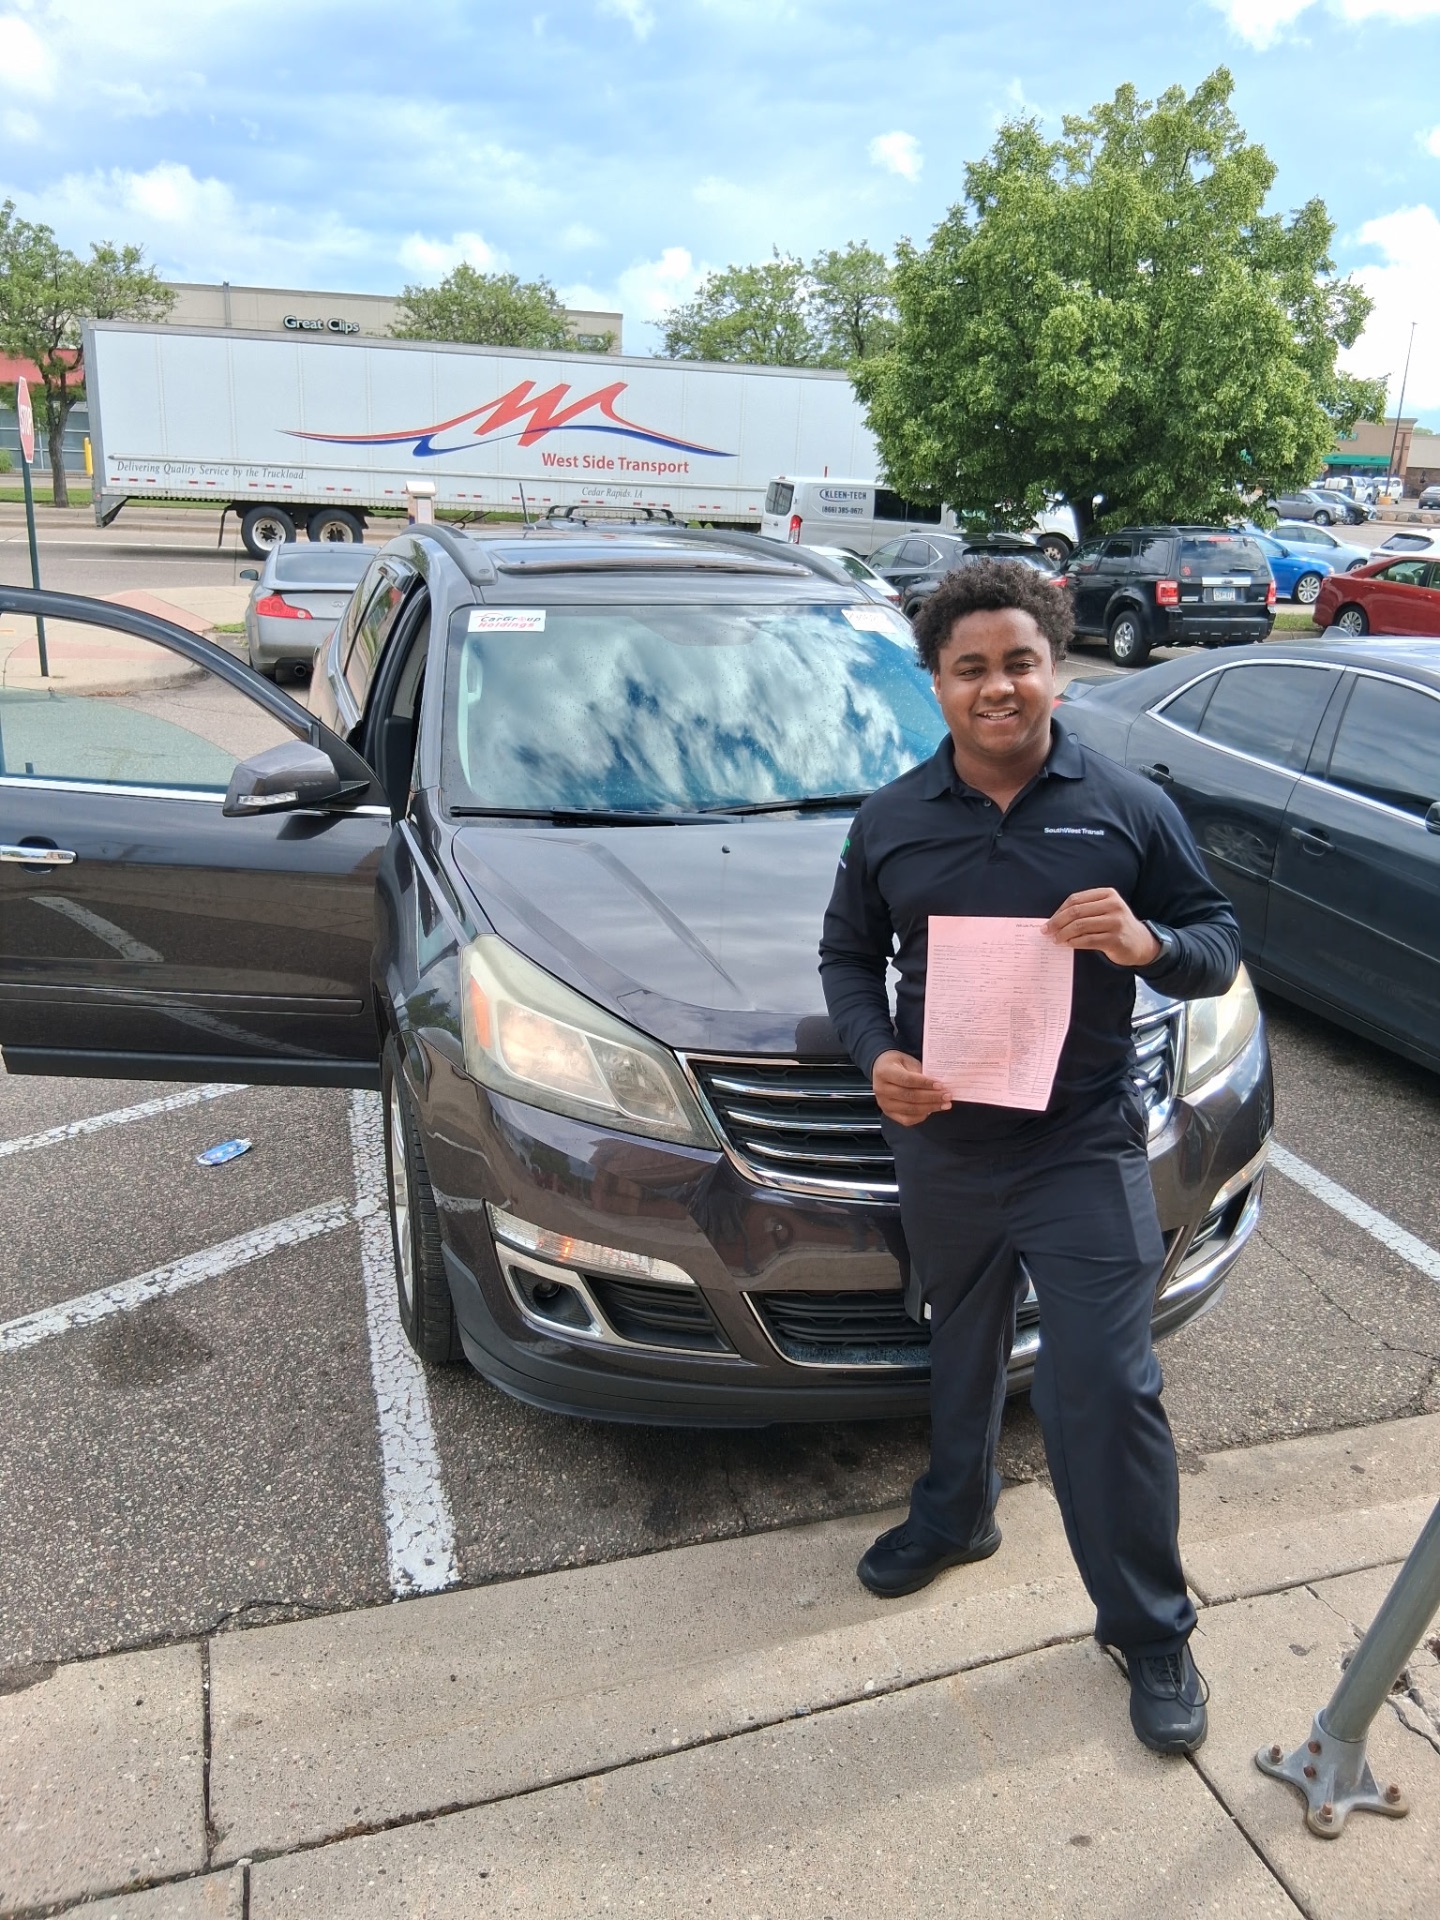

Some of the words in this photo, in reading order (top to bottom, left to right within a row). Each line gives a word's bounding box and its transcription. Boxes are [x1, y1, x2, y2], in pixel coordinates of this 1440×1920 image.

[283, 315, 324, 330] Great
[327, 318, 360, 335] Clips
[117, 461, 160, 474] Delivering
[163, 463, 196, 476] Quality
[199, 464, 230, 476] Service
[232, 468, 243, 478] by
[246, 467, 259, 477] the
[262, 467, 307, 480] Truckload.
[542, 453, 579, 468] West
[583, 455, 615, 470] Side
[618, 457, 690, 475] Transport
[582, 487, 604, 497] Cedar
[634, 490, 644, 499] IA
[825, 491, 867, 500] KLEEN-TECH
